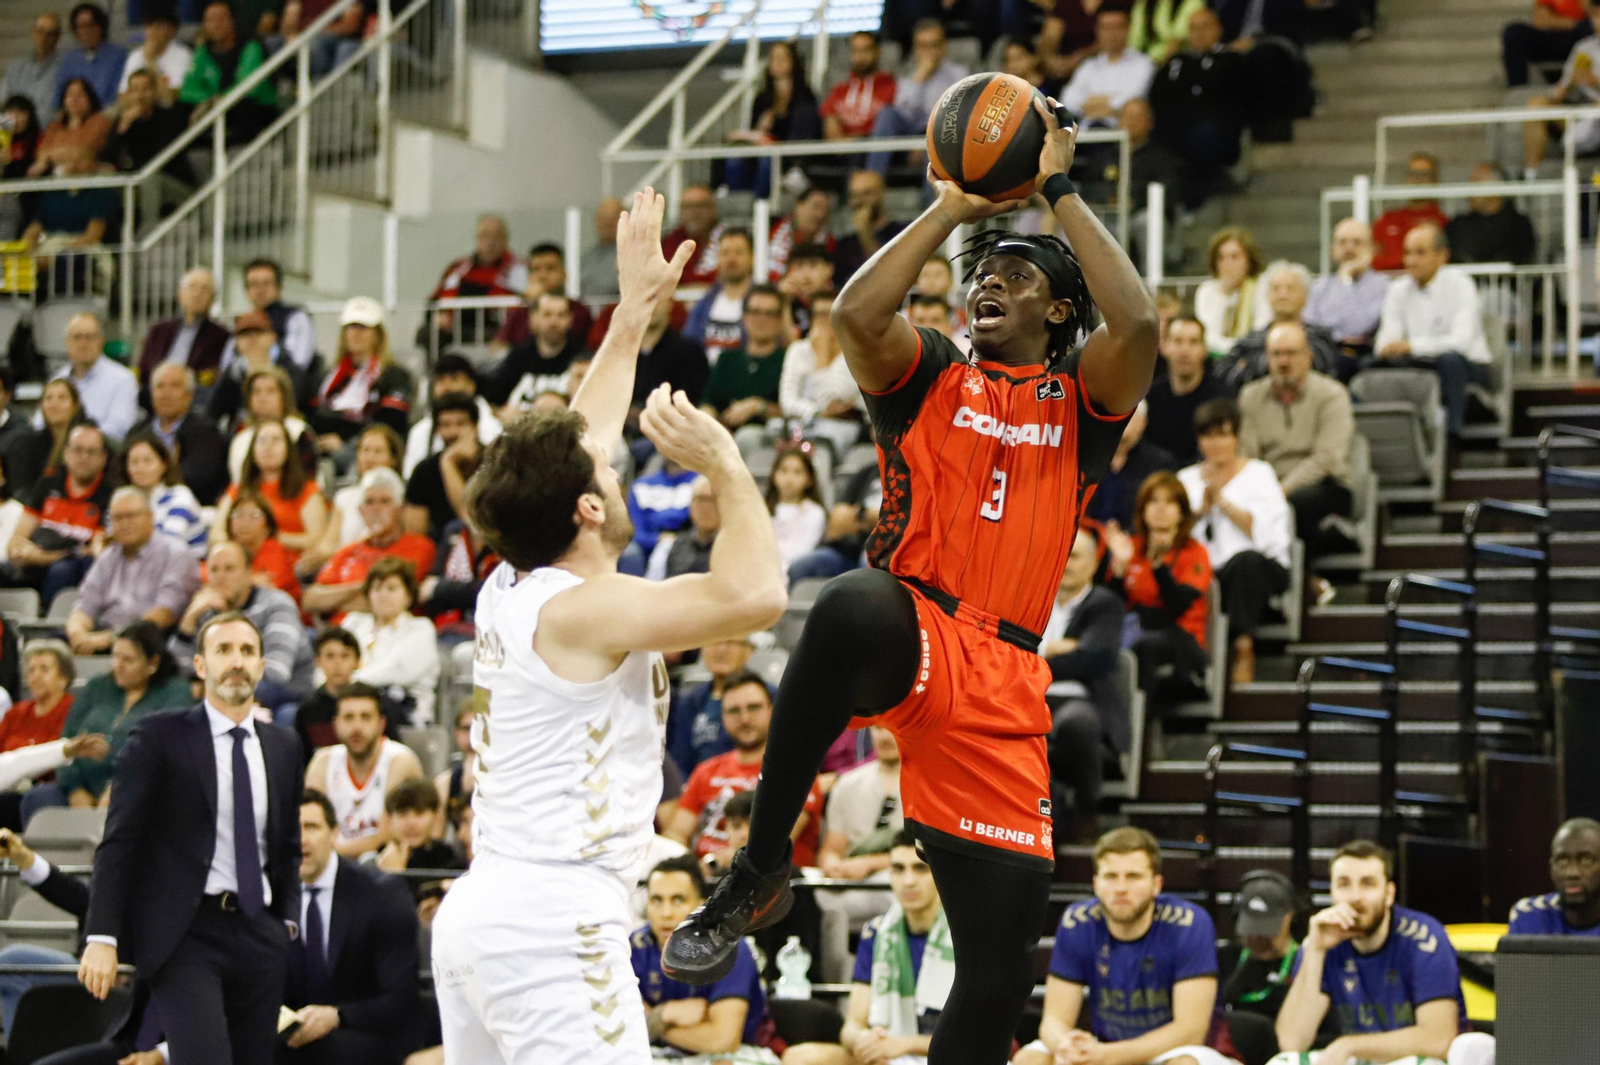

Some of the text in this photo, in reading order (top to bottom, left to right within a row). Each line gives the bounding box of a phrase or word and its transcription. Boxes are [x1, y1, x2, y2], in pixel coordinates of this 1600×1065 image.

[973, 80, 1012, 146] LEGACY
[952, 405, 1063, 447] COVRAN
[980, 466, 1007, 523] 3
[975, 822, 1035, 846] BERNER
